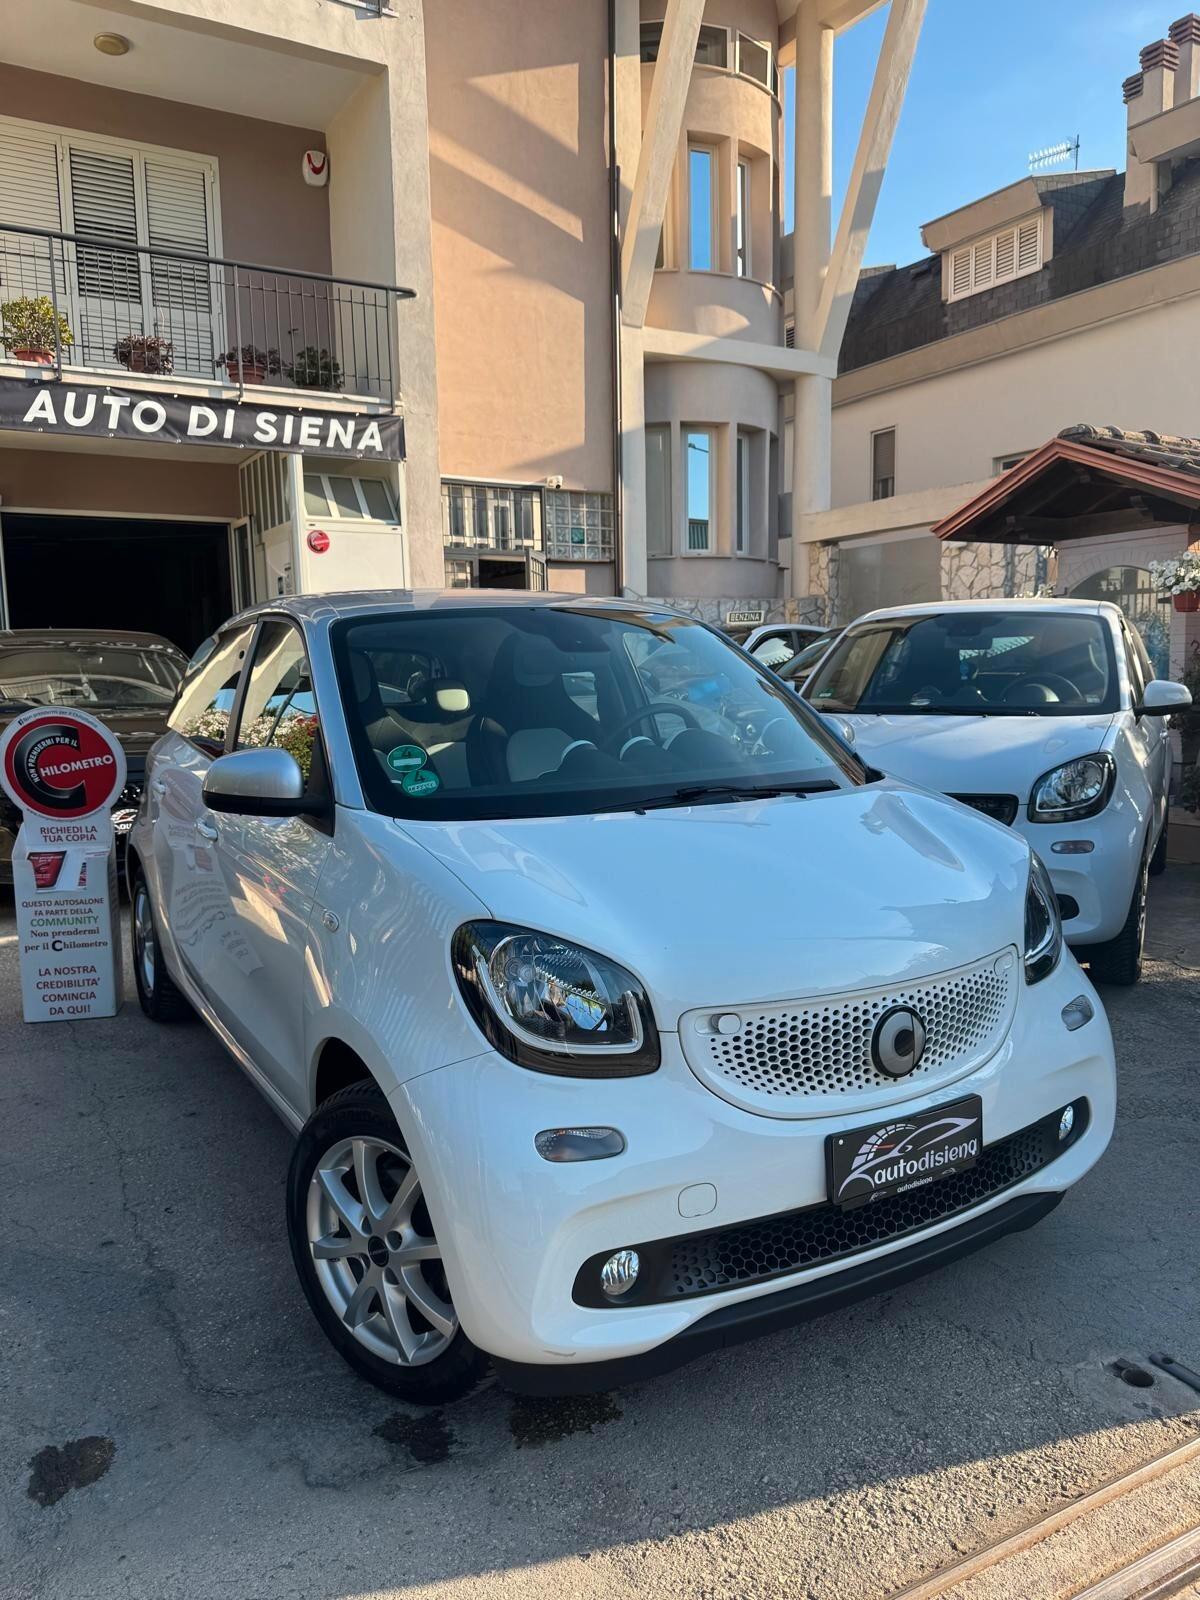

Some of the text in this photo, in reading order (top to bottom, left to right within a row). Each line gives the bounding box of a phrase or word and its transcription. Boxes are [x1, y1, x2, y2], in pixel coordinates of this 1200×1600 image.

[23, 389, 384, 452] AUTO DI SIENA
[730, 613, 760, 621] BENZINA
[55, 736, 70, 745] PER
[28, 737, 55, 768] PRENDERMI
[28, 768, 41, 783] NON
[40, 825, 98, 835] RICHIEDI LA
[43, 833, 97, 843] TUA COPIA
[22, 897, 105, 908] QUESTO AUTOSALONE
[70, 907, 94, 915] DELLA
[30, 915, 99, 927] COMMUNITY
[30, 926, 100, 938] Non prendermi
[24, 944, 41, 953] per
[42, 942, 50, 950] il
[38, 965, 97, 977] LA NOSTRA
[36, 977, 101, 990] CREDIBILITA'
[42, 991, 97, 1003] COMINCIA
[49, 1004, 91, 1016] DA QUI!
[874, 1138, 978, 1185] autodisiena
[897, 1176, 933, 1193] autodisiena
